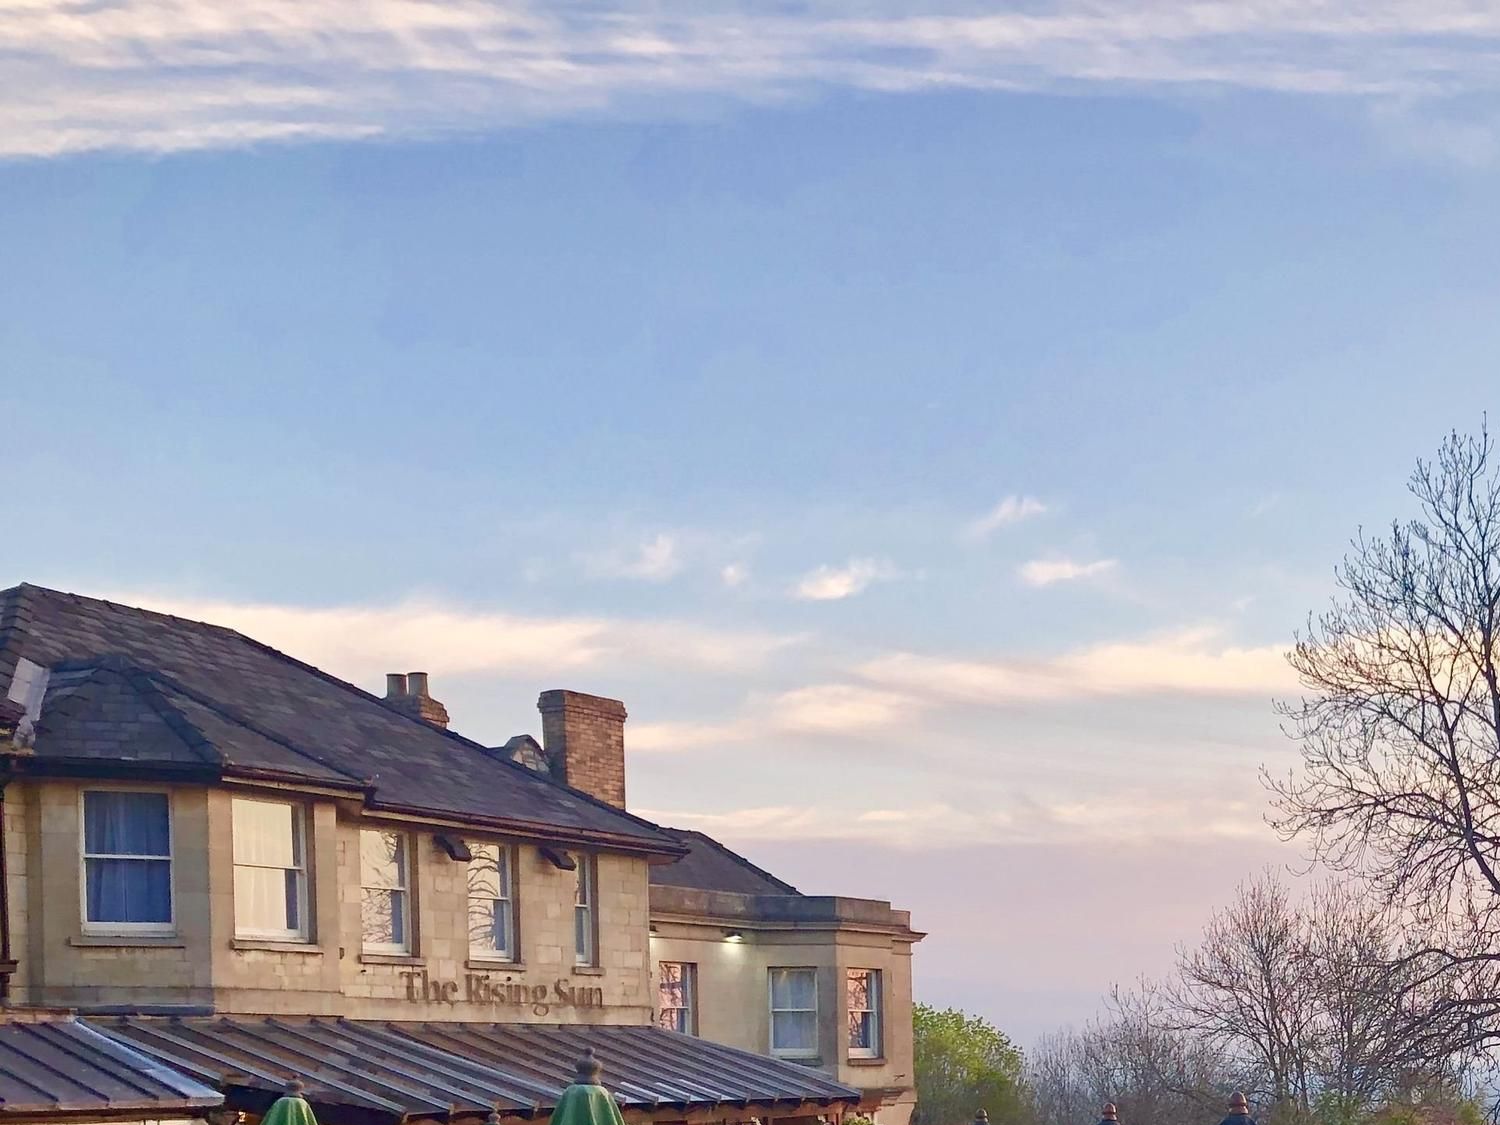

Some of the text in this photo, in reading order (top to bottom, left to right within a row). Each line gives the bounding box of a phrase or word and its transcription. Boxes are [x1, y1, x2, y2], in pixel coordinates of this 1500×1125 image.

[400, 970, 603, 1016] The Rising Sun
